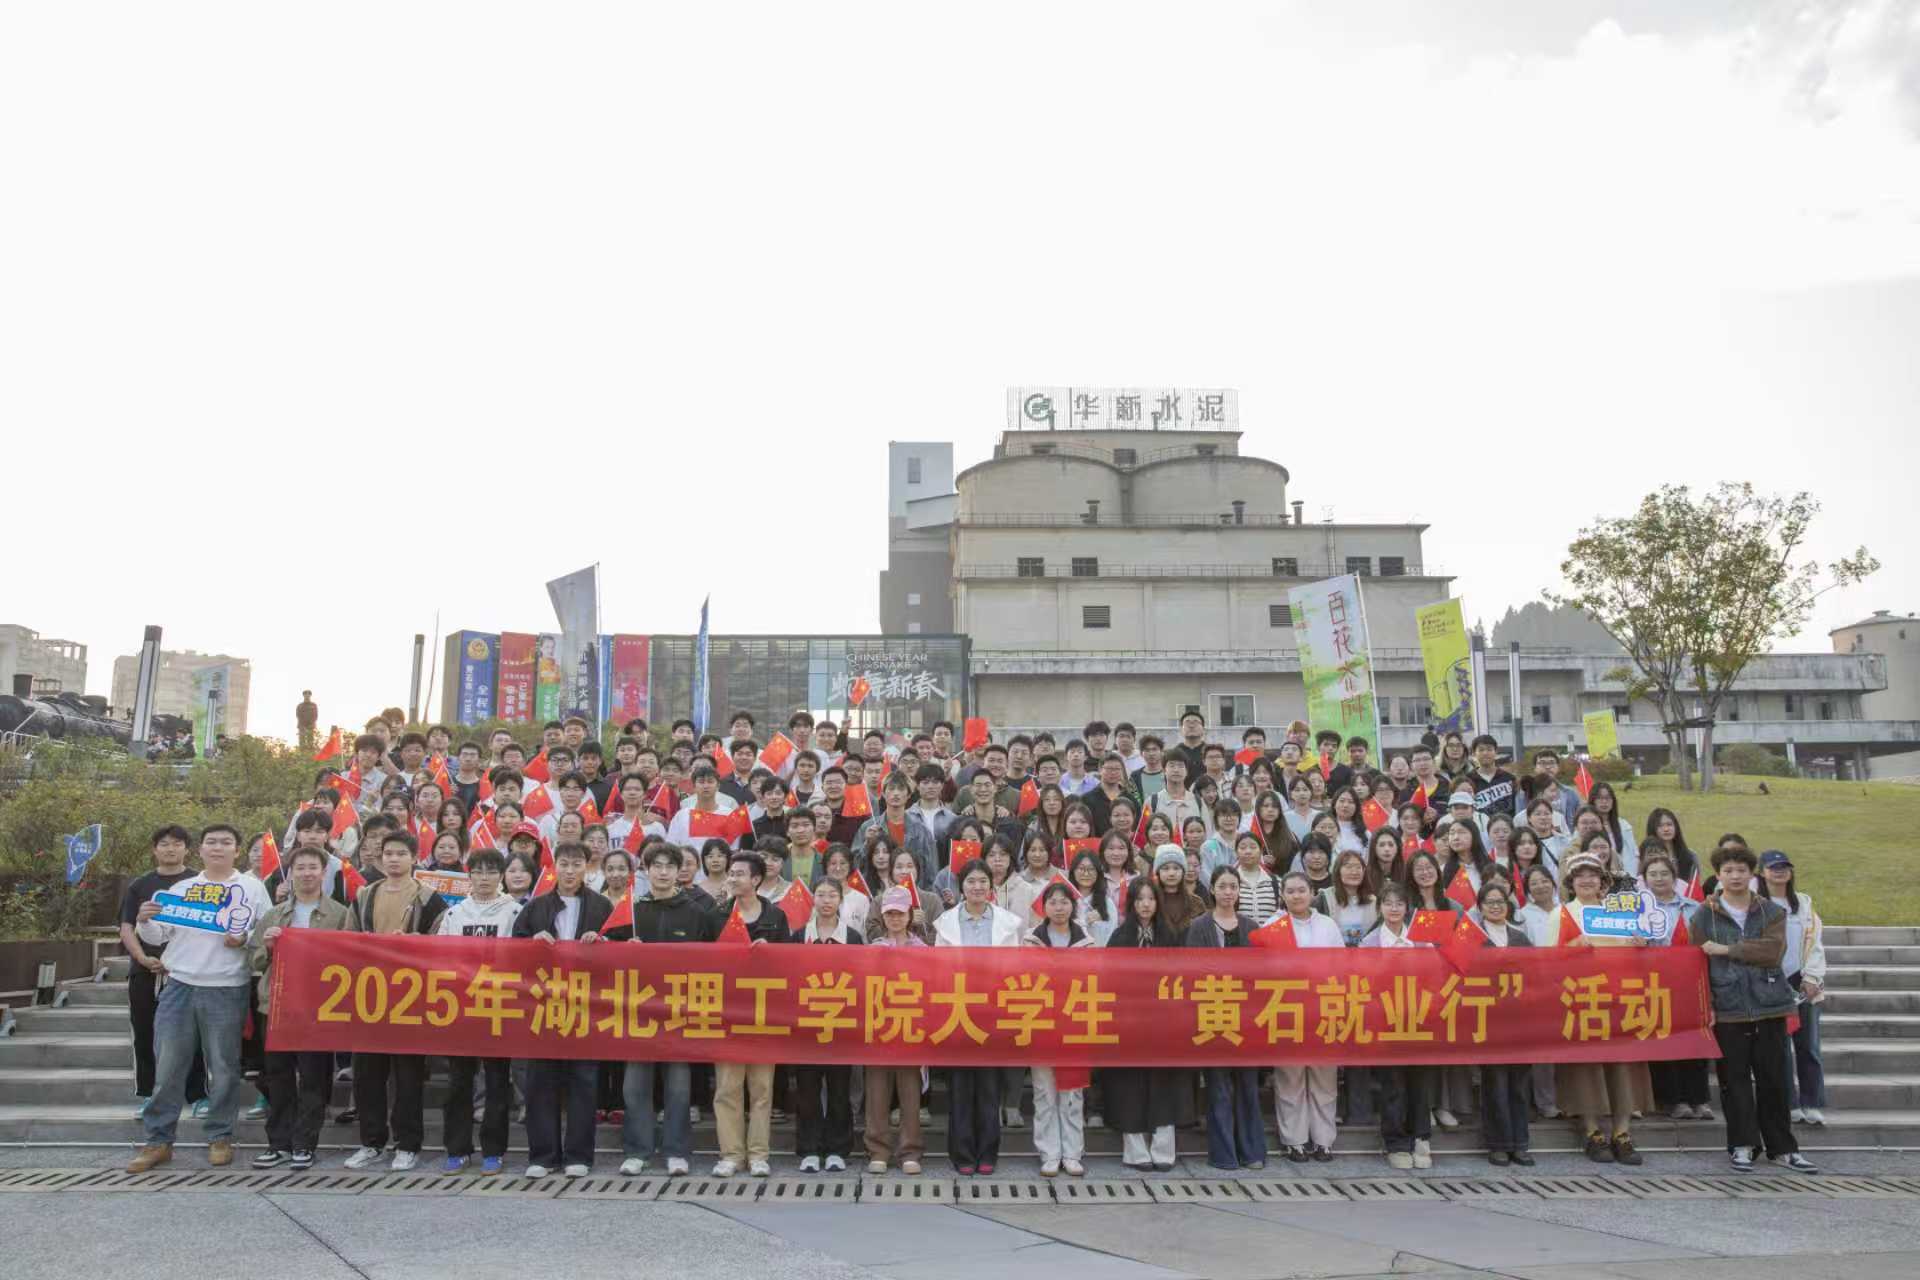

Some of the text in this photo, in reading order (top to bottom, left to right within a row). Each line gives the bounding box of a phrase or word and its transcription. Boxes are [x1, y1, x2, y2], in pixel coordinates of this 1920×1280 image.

[1073, 393, 1224, 421] 华新水泥
[847, 653, 928, 663] CHINESE YEAR
